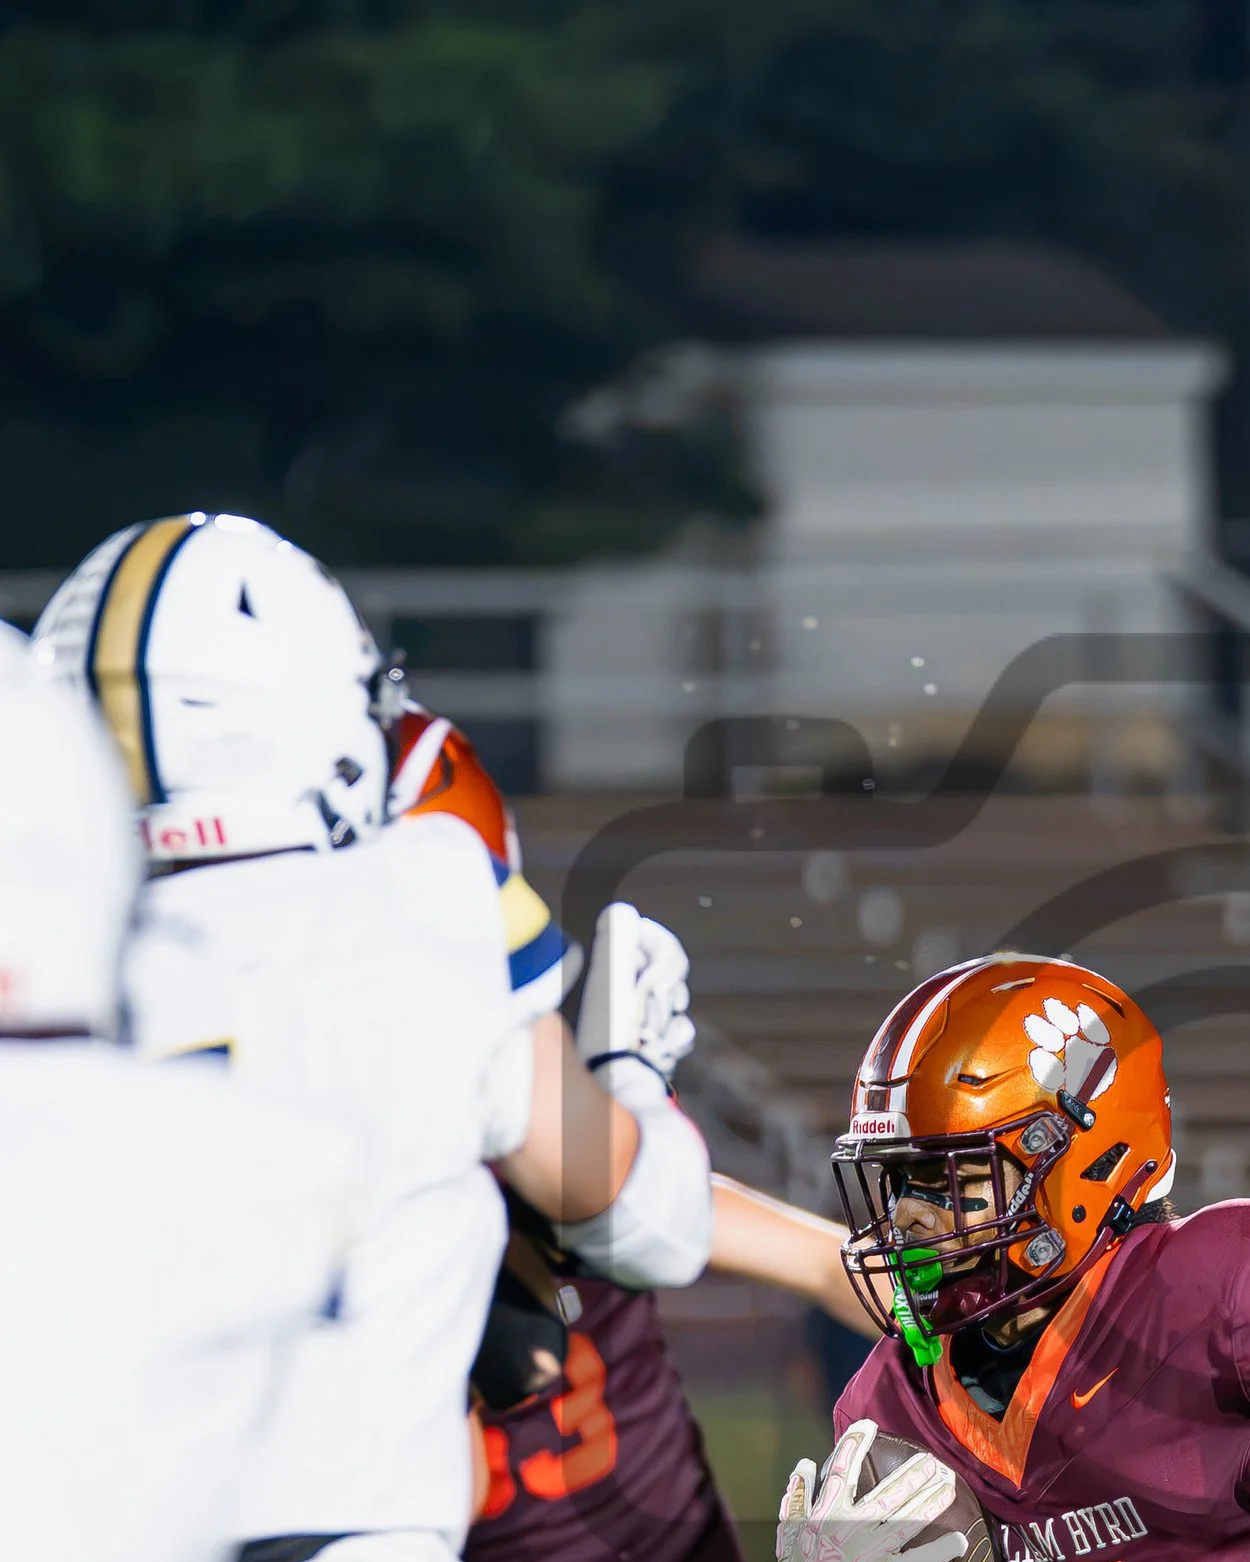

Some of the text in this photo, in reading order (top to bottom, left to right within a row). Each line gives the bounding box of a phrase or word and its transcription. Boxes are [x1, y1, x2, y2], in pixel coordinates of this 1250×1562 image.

[853, 1119, 895, 1135] Riddell
[1007, 1171, 1035, 1217] iddell
[1061, 1496, 1148, 1555] BYRD
